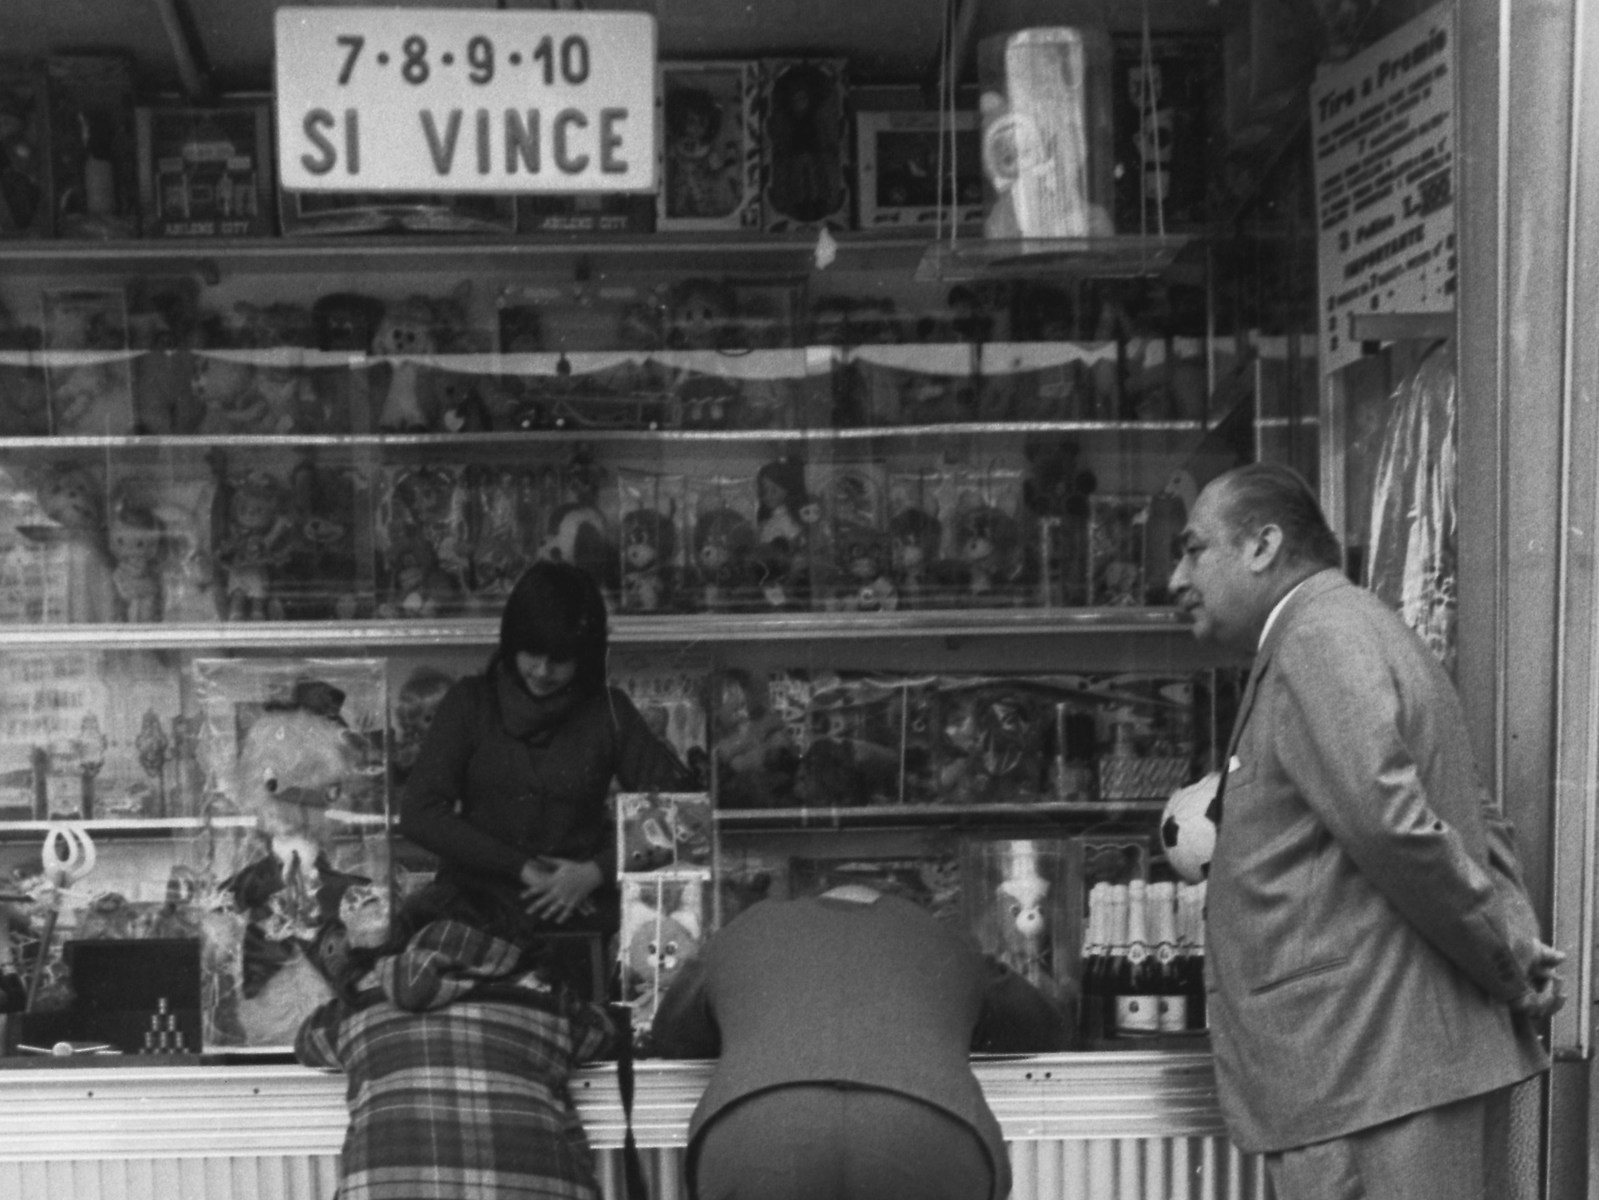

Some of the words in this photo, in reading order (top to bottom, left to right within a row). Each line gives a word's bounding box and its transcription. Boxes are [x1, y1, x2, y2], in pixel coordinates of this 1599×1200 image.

[1377, 26, 1448, 88] Premio
[302, 108, 359, 175] SI
[420, 107, 629, 175] VINCE
[1344, 223, 1425, 280] IMPORTANTE
